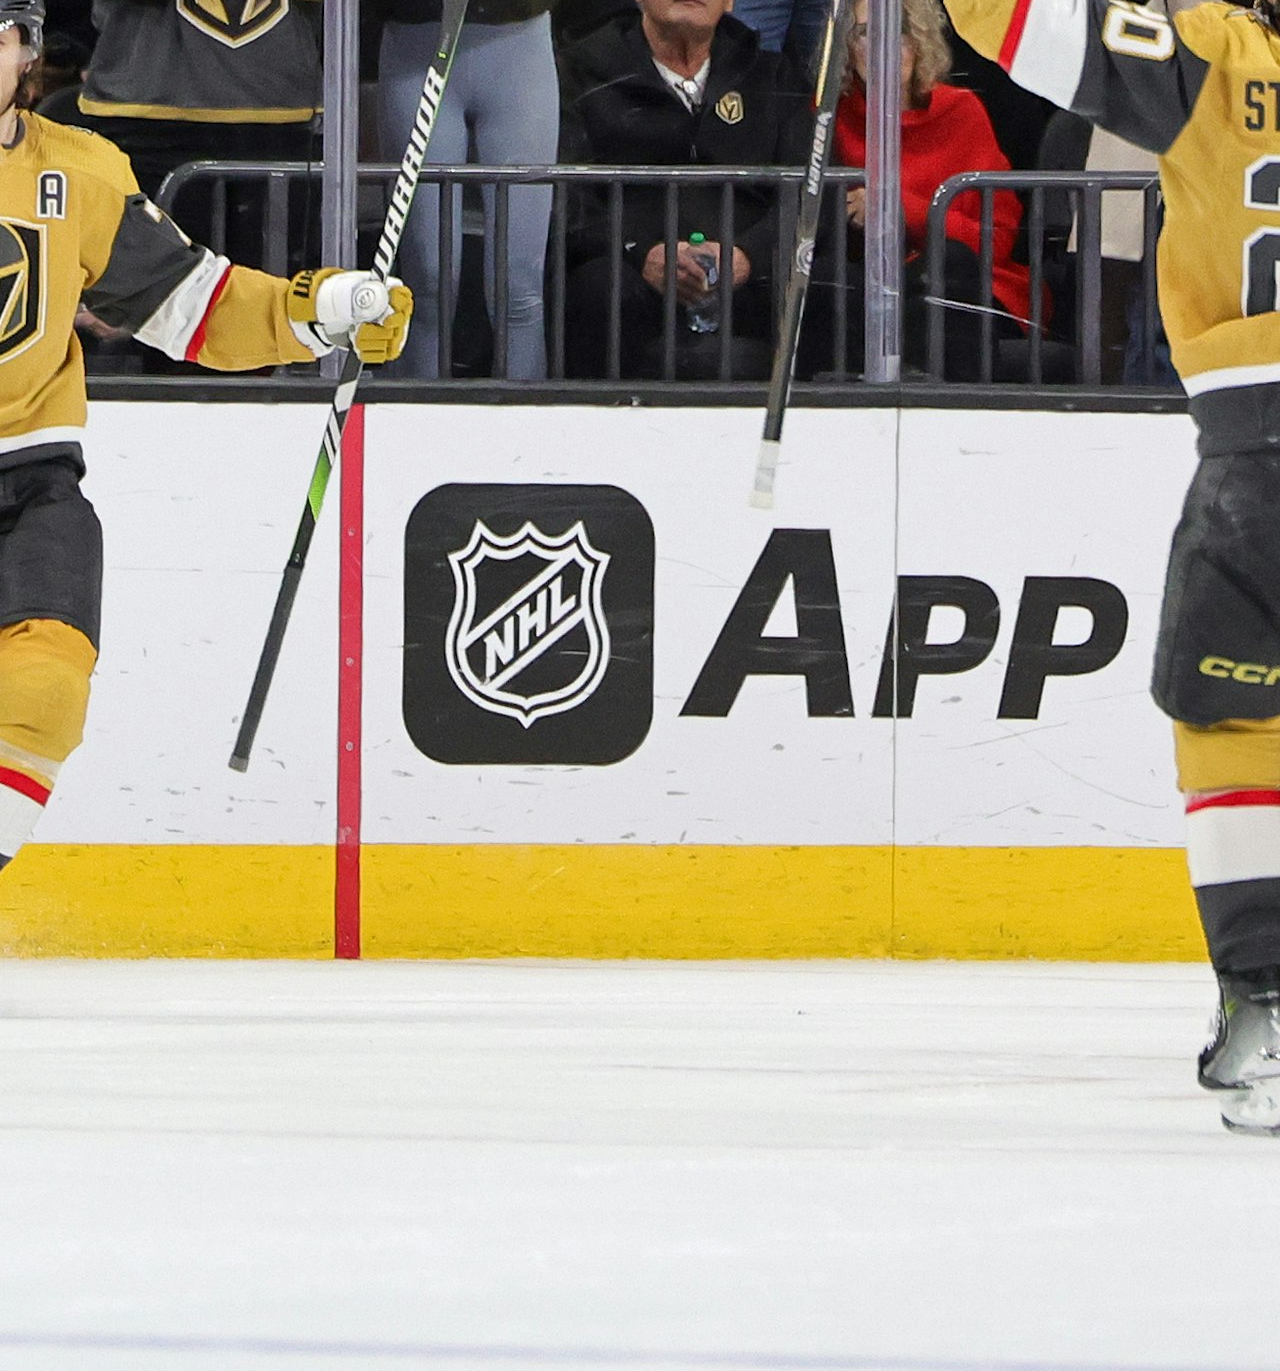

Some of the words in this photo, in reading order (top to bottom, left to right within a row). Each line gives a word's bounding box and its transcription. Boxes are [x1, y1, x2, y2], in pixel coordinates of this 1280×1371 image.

[36, 169, 69, 221] A
[369, 65, 447, 286] WARRIOR
[482, 575, 578, 680] NHL
